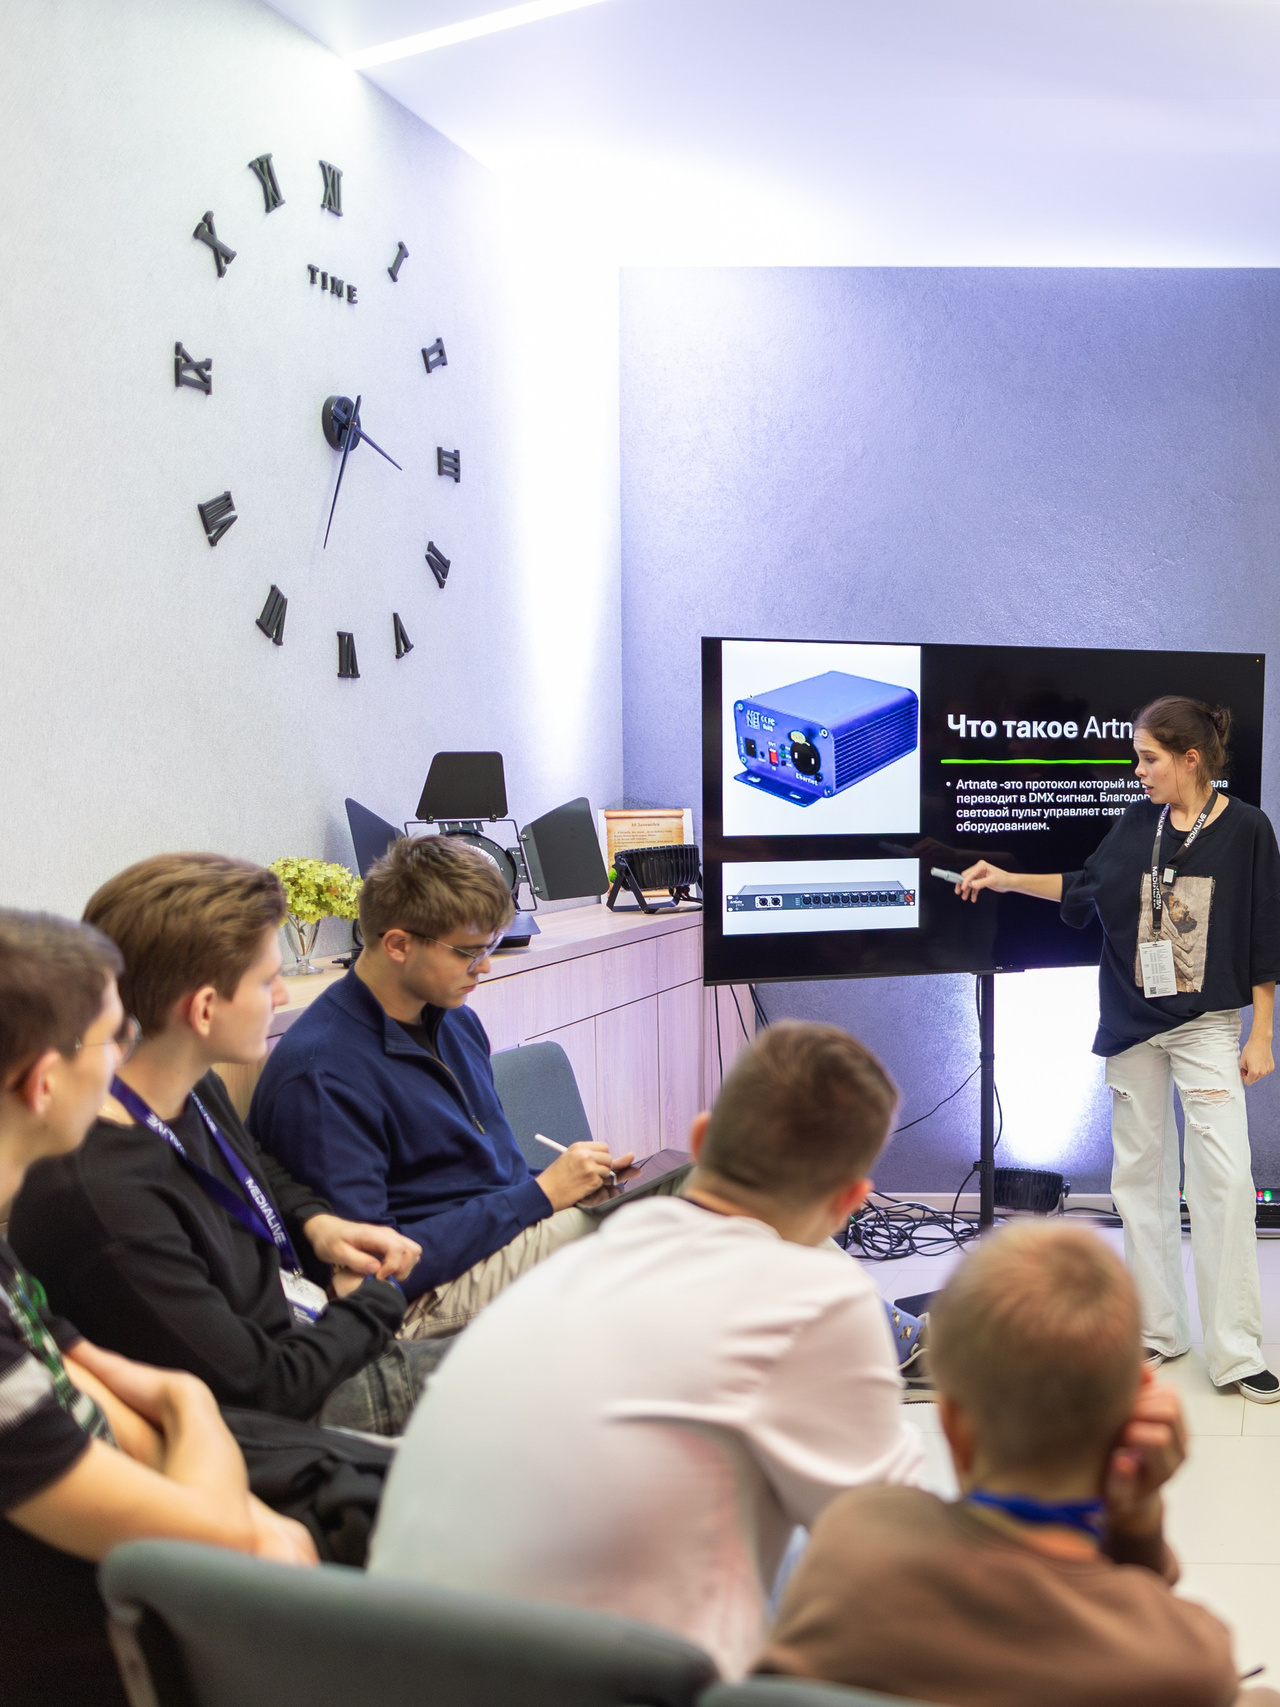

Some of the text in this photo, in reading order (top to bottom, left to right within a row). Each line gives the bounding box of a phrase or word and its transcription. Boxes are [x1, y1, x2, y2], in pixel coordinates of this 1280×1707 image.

[318, 160, 343, 217] XII
[307, 263, 358, 304] TIME
[437, 446, 460, 483] III
[947, 714, 1133, 739] Что такое Artn
[956, 779, 998, 790] Artnate
[1025, 780, 1077, 791] протокол
[1079, 778, 1125, 790] который
[956, 794, 1018, 805] переводит
[1028, 792, 1055, 803] DMX
[1056, 794, 1097, 803] сигнал.
[956, 806, 1126, 819] световой пульт управляет свет
[956, 821, 1050, 833] оборудованием.
[1184, 812, 1207, 848] MEDIALIVE
[245, 1175, 287, 1247] MEDIALIVE
